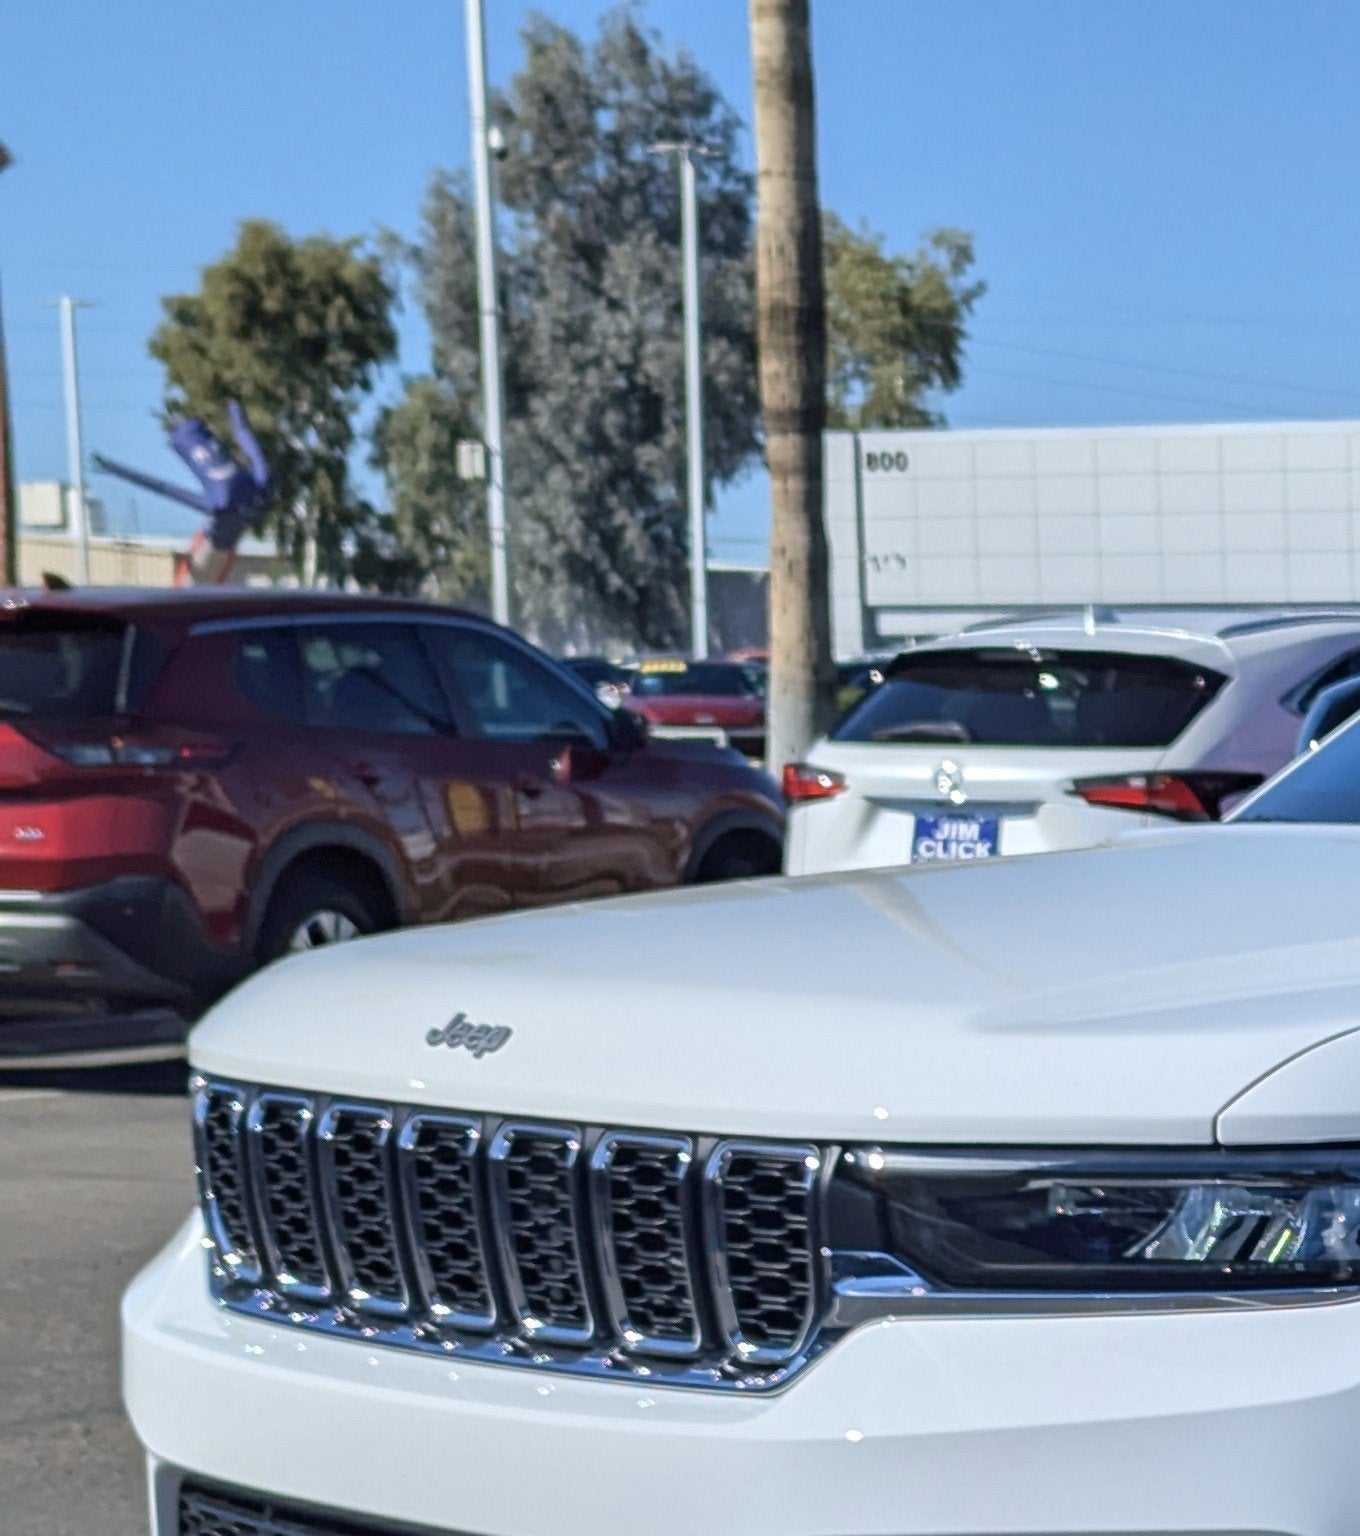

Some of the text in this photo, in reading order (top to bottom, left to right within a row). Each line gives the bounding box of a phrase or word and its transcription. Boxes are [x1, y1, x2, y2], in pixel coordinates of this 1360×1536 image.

[866, 451, 909, 473] 800
[931, 818, 981, 840] JIM
[919, 839, 992, 860] CLICK
[425, 1011, 514, 1060] Jeep
